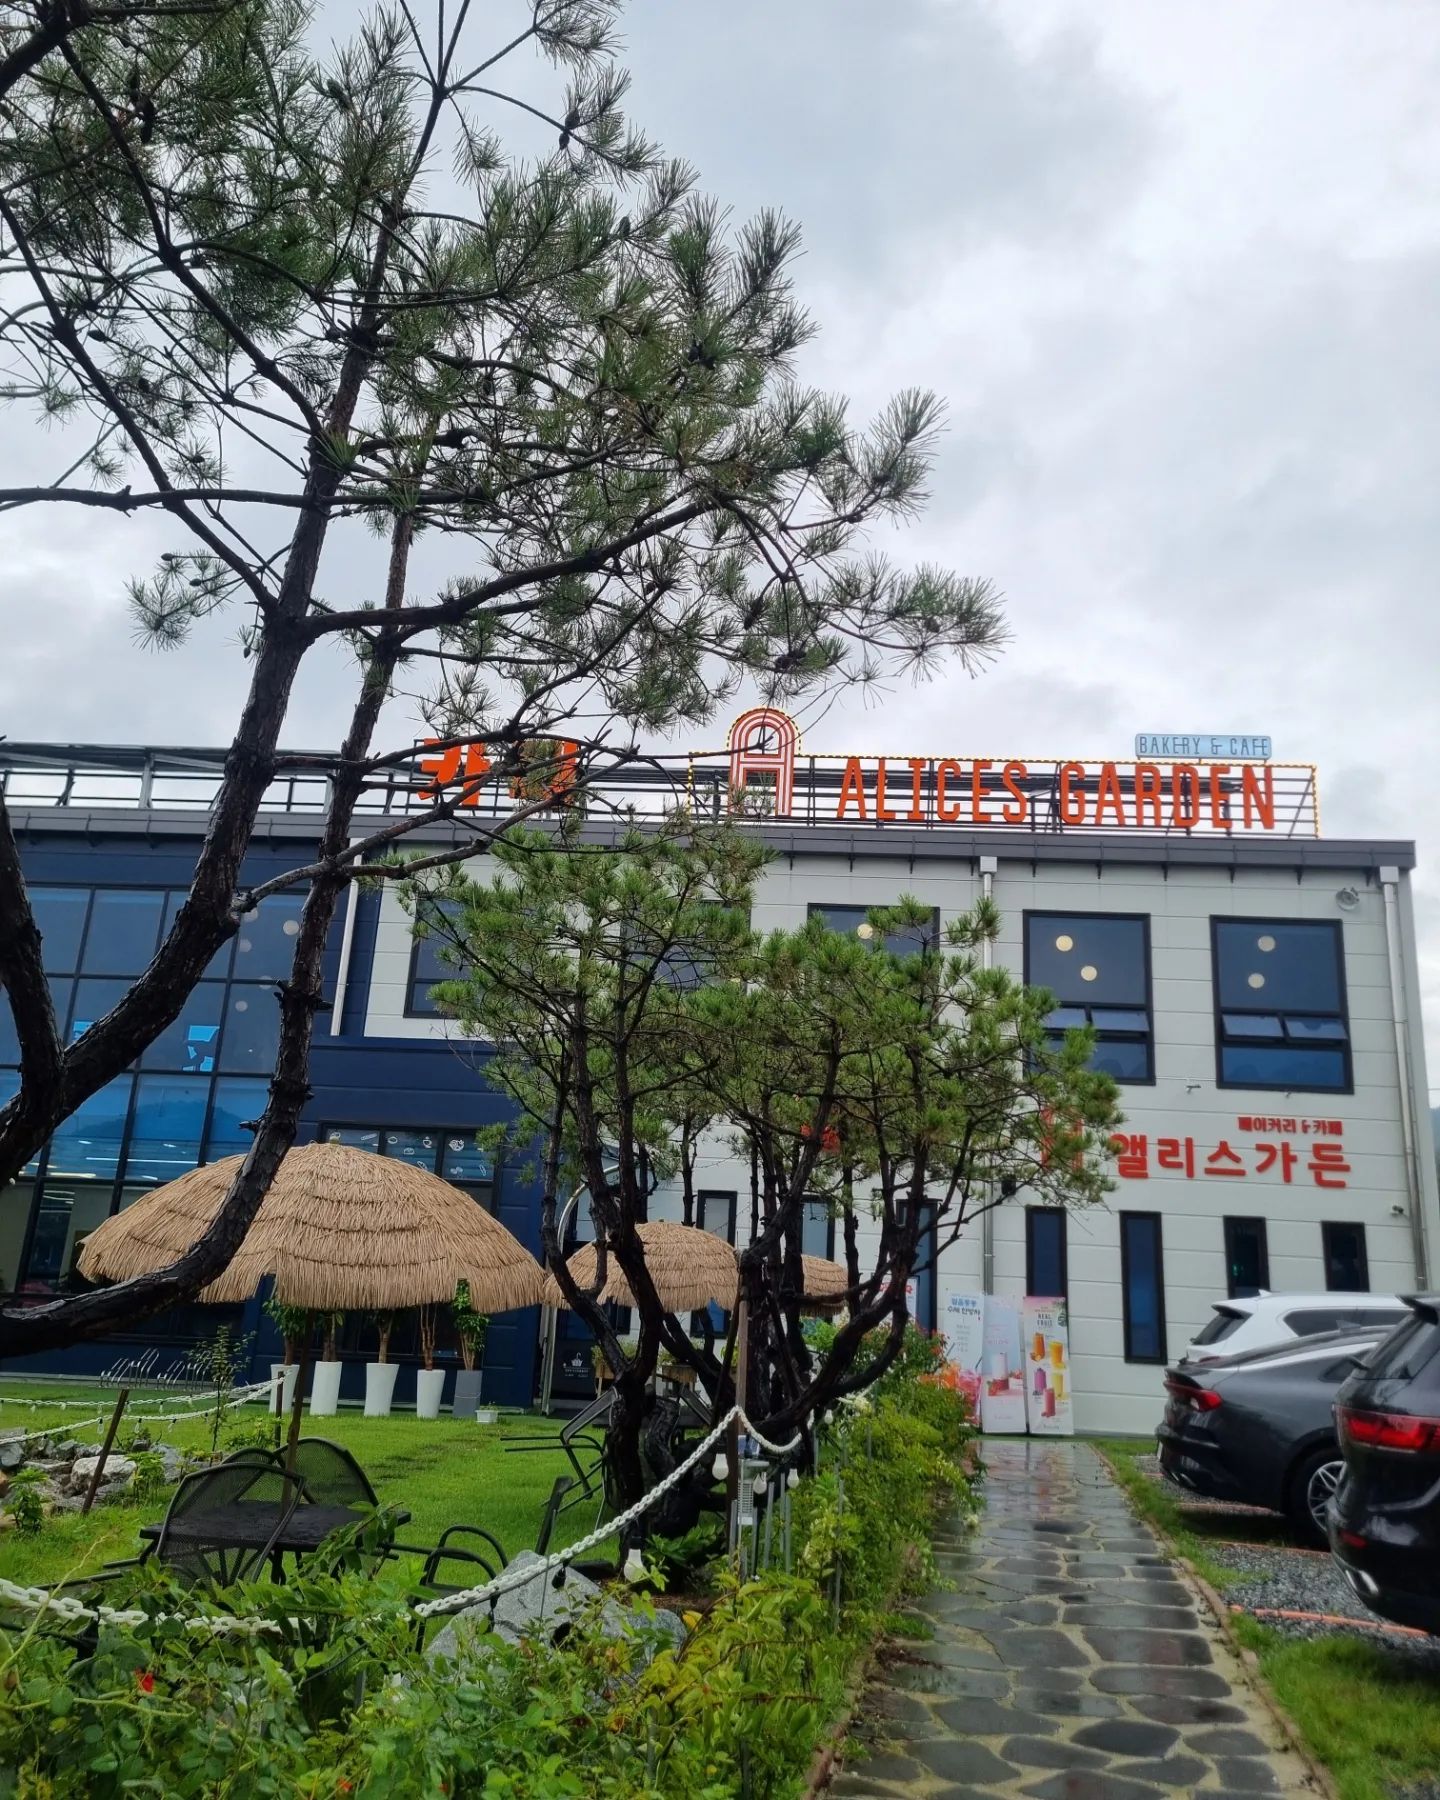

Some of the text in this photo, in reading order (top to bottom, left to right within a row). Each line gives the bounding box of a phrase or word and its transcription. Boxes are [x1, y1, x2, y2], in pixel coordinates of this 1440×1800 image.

[1139, 736, 1269, 756] BAKERY & CAFE
[837, 757, 1275, 830] ALICES GARDEN
[1109, 1133, 1351, 1188] 앨리스가든
